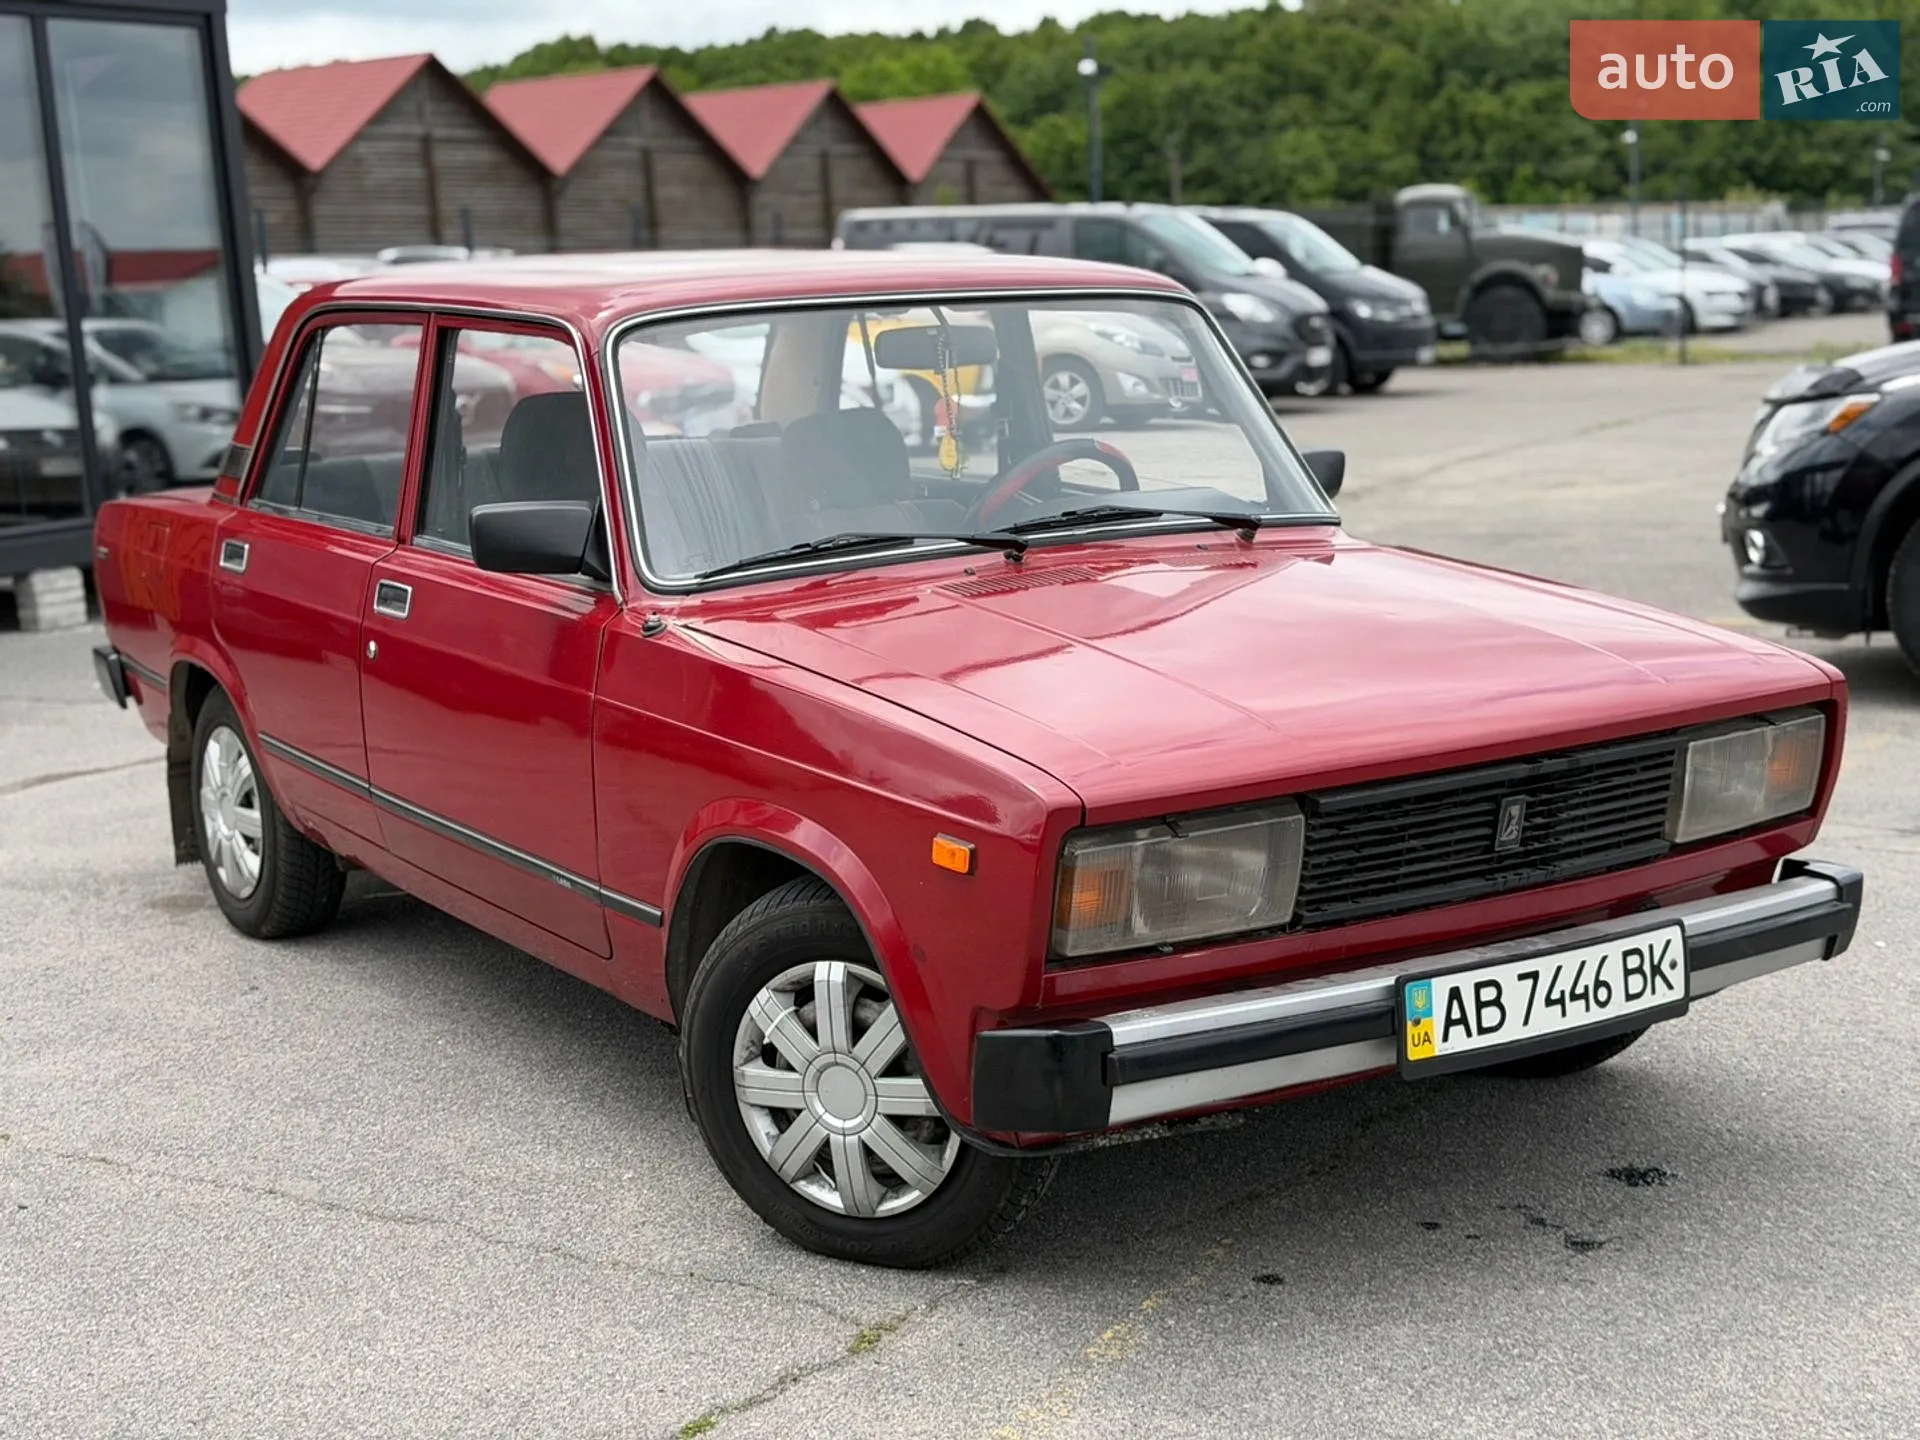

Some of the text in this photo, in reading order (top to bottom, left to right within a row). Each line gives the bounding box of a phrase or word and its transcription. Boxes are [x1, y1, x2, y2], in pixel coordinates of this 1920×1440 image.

[1441, 938, 1675, 1044] AB 7446 BK
[1411, 1031, 1432, 1048] UA
